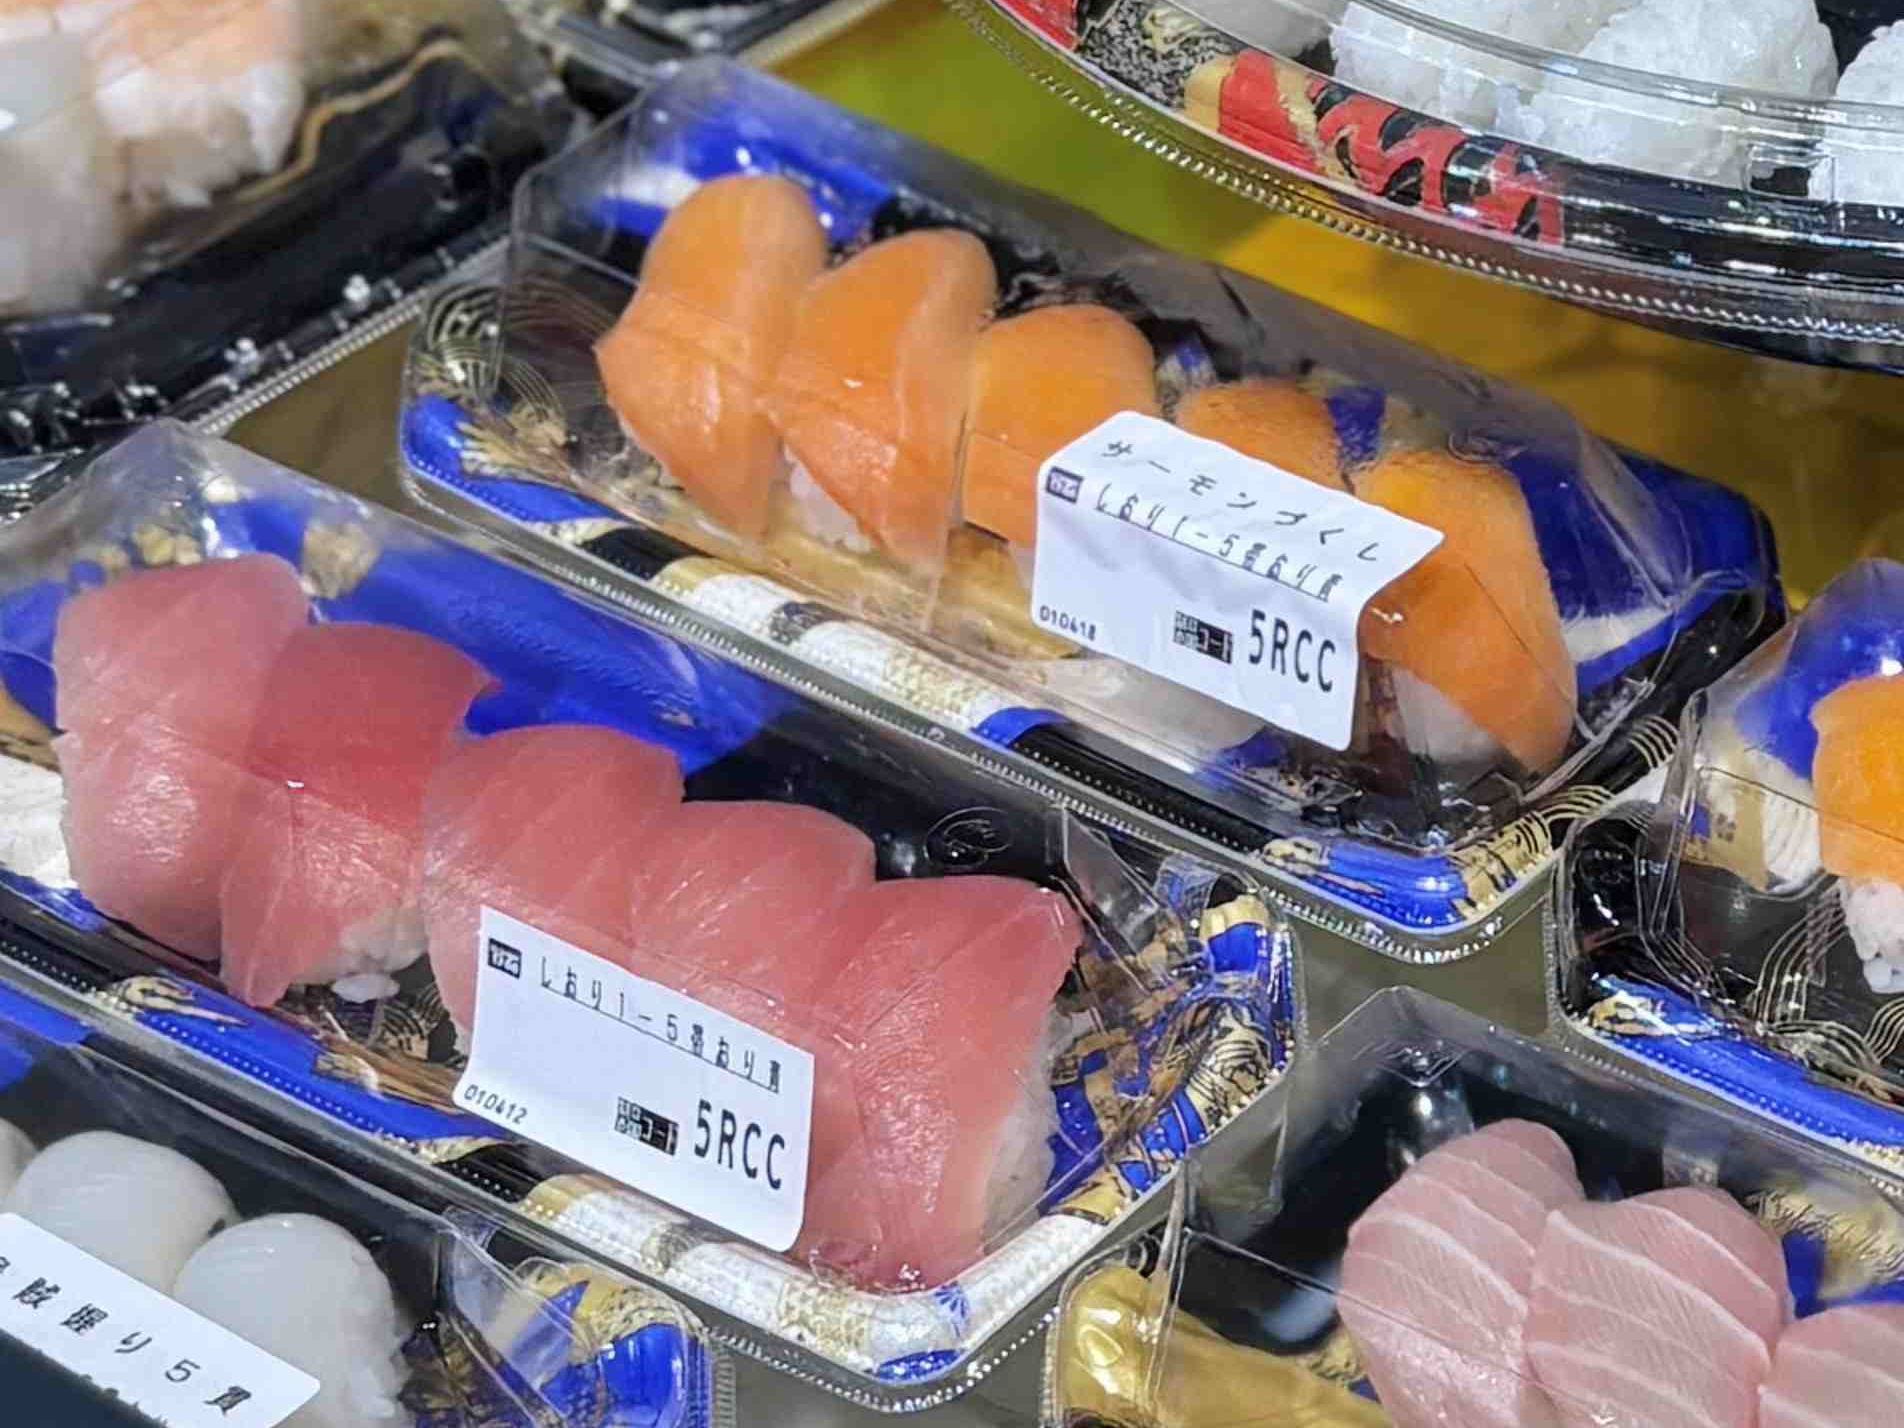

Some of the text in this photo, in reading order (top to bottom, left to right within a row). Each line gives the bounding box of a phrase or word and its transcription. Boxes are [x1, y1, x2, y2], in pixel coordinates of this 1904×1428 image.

[1039, 604, 1097, 642] 010418
[1248, 608, 1337, 693] 5RCC
[463, 1085, 528, 1124] 010412
[694, 1099, 785, 1190] 5RCC
